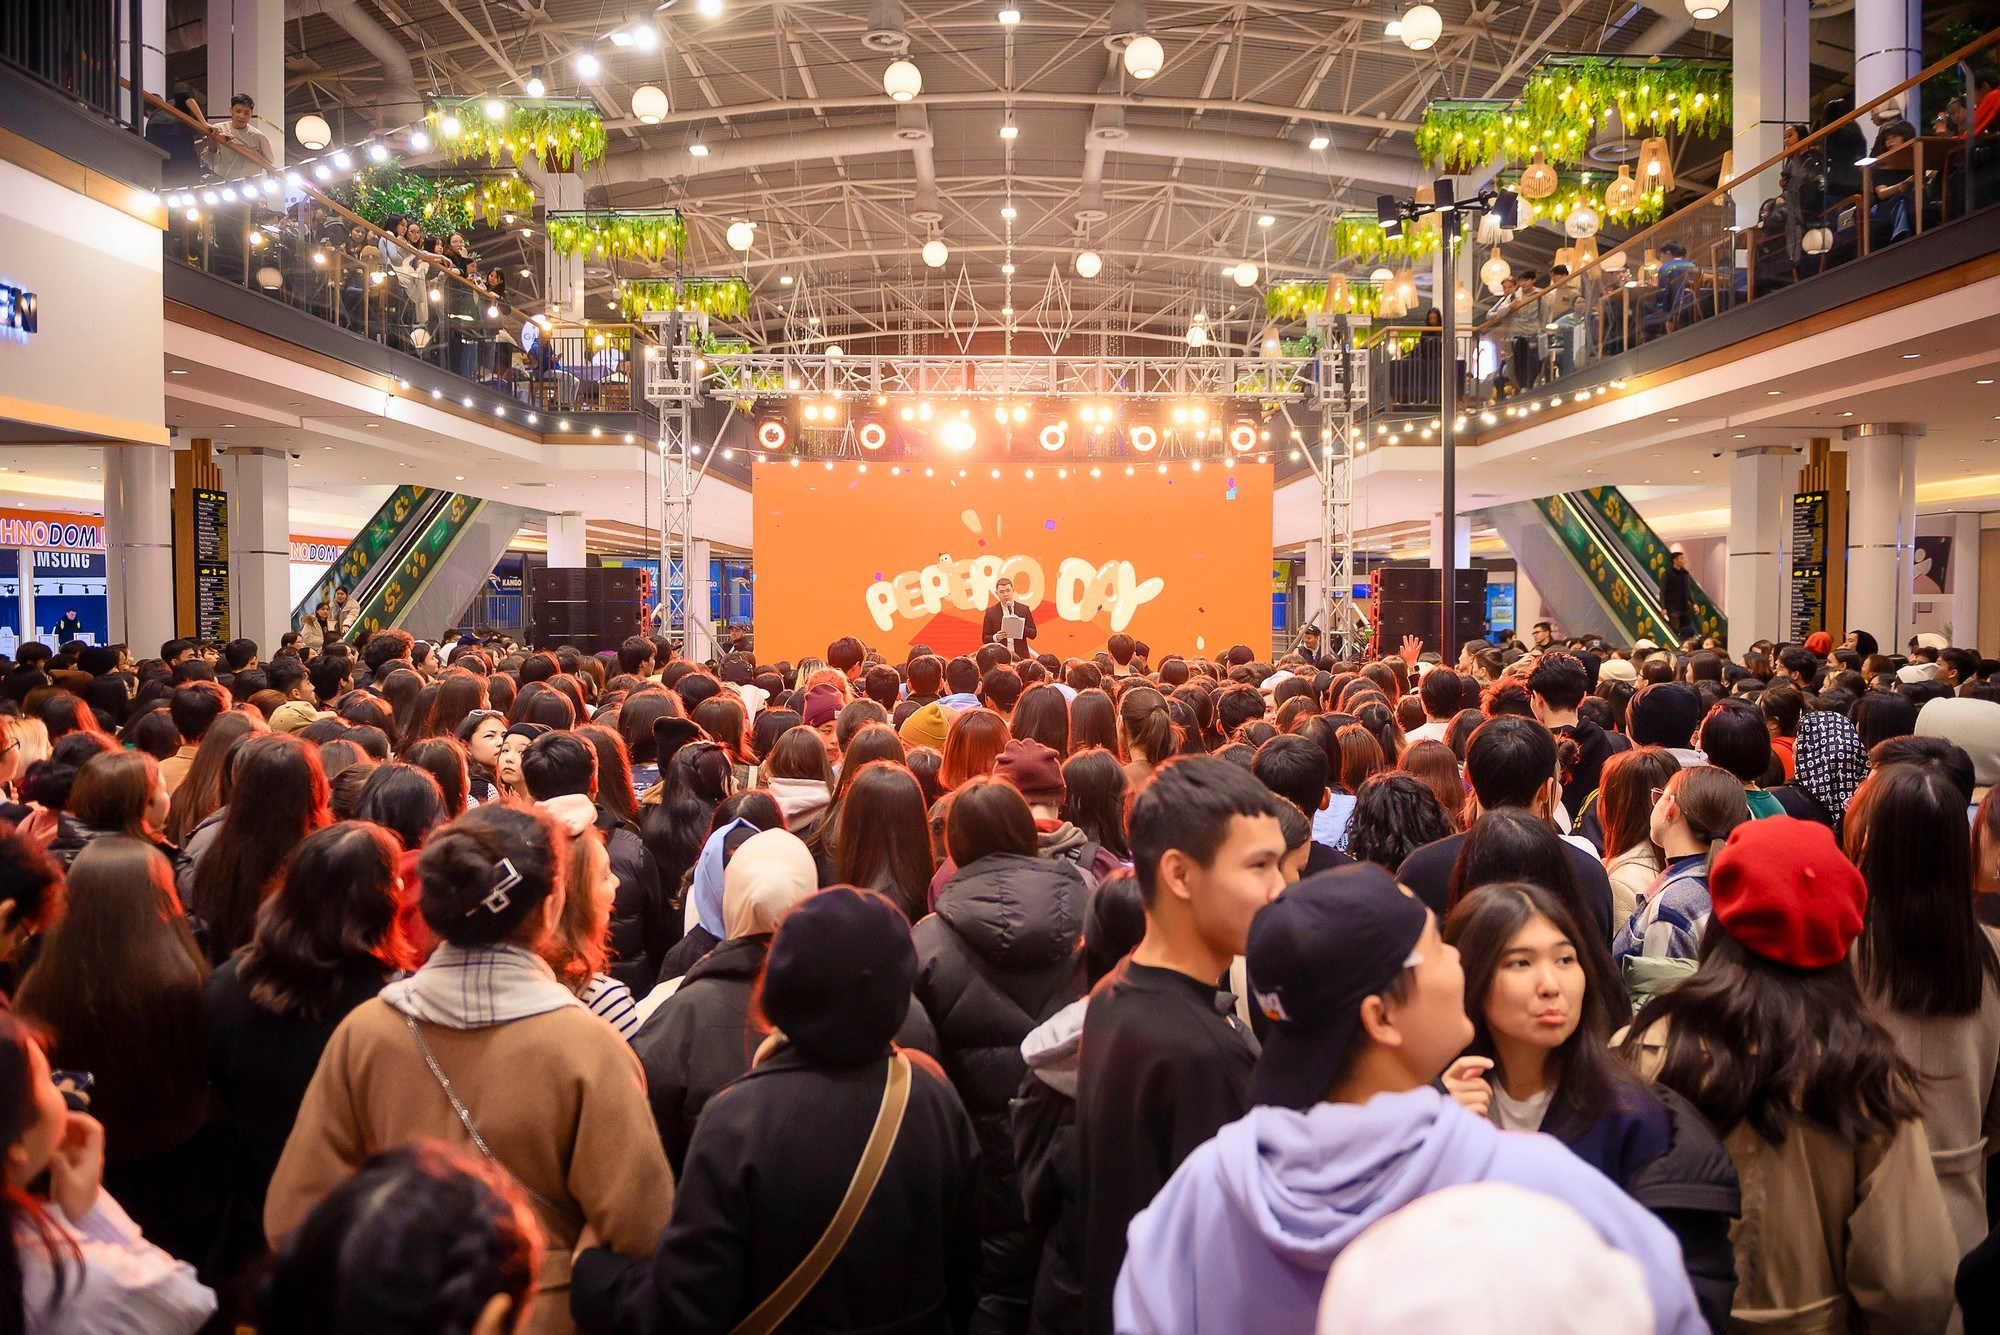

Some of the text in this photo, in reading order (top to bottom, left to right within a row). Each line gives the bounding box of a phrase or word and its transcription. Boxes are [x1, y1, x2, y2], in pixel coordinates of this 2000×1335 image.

[0, 518, 106, 549] HNODOM.
[33, 552, 90, 568] MSUNG
[502, 578, 522, 587] KANGO
[866, 554, 1164, 632] PEPERO DAY
